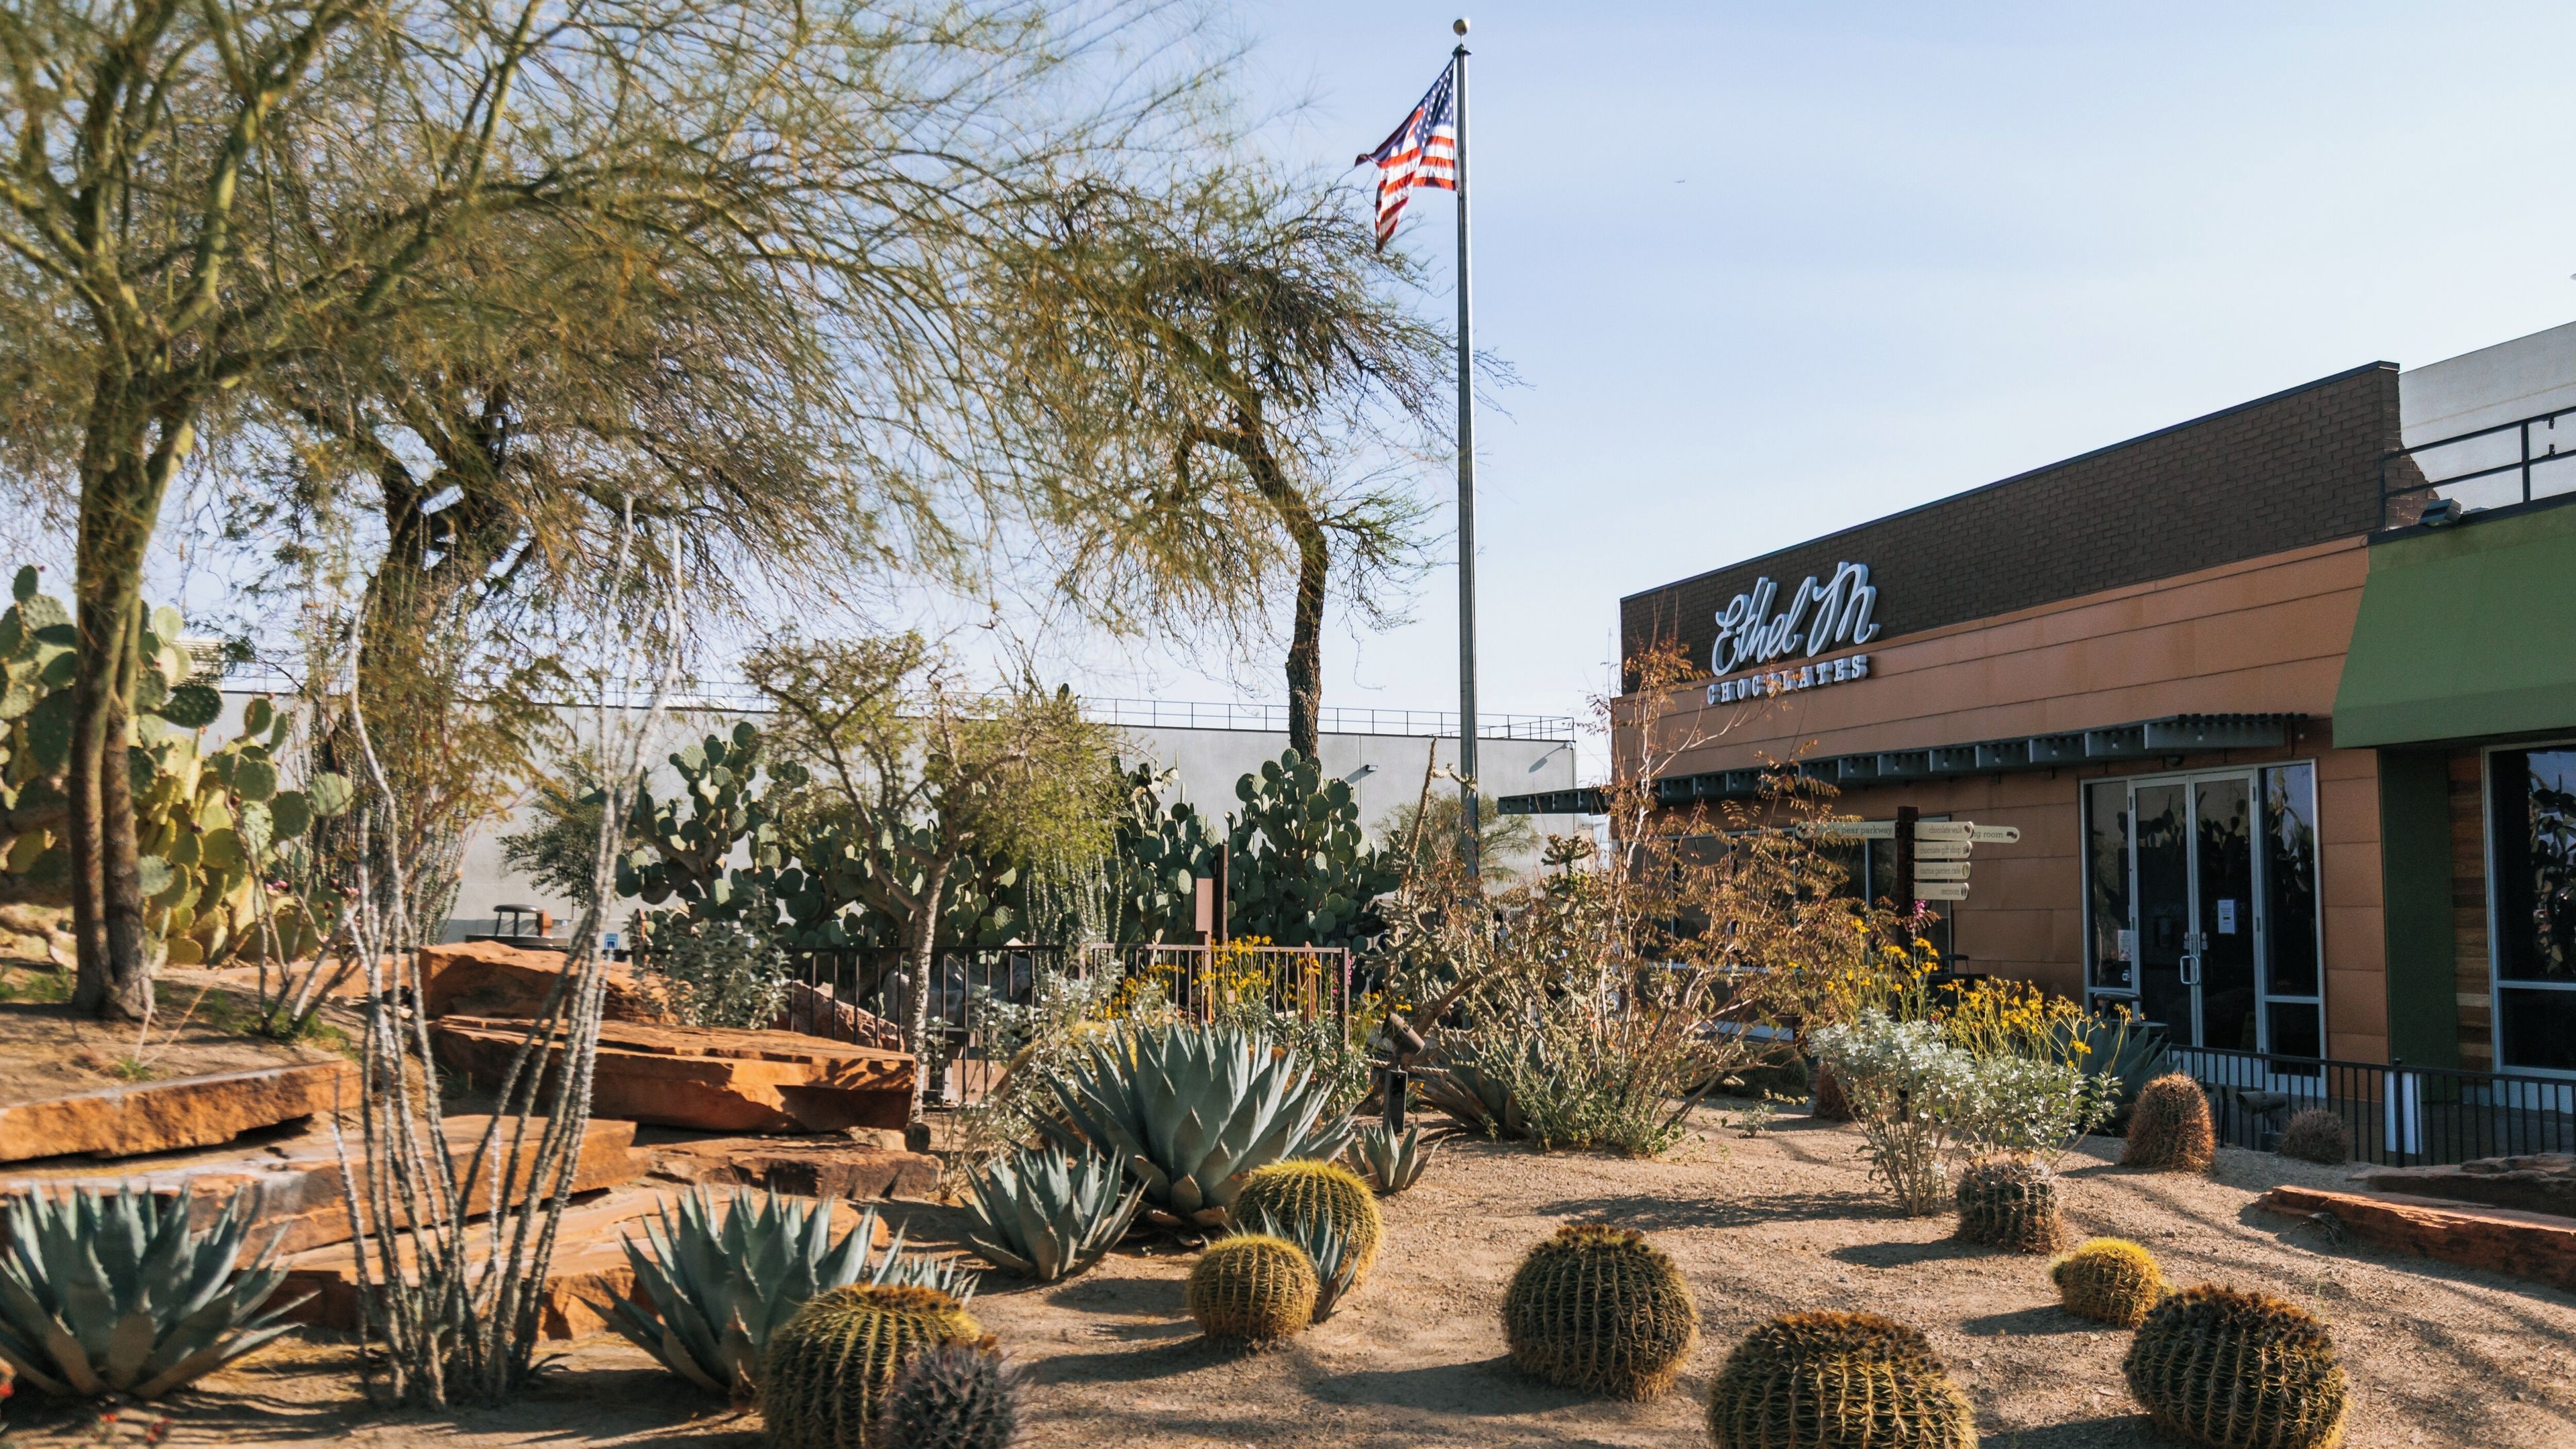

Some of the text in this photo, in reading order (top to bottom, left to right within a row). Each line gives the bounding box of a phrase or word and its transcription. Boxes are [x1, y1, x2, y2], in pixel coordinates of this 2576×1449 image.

[1712, 561, 1881, 677] Ethel M
[1841, 827, 1859, 836] pear
[1860, 825, 1893, 836] parkway
[1929, 824, 1951, 834] chocolate
[1949, 845, 1961, 855] shop
